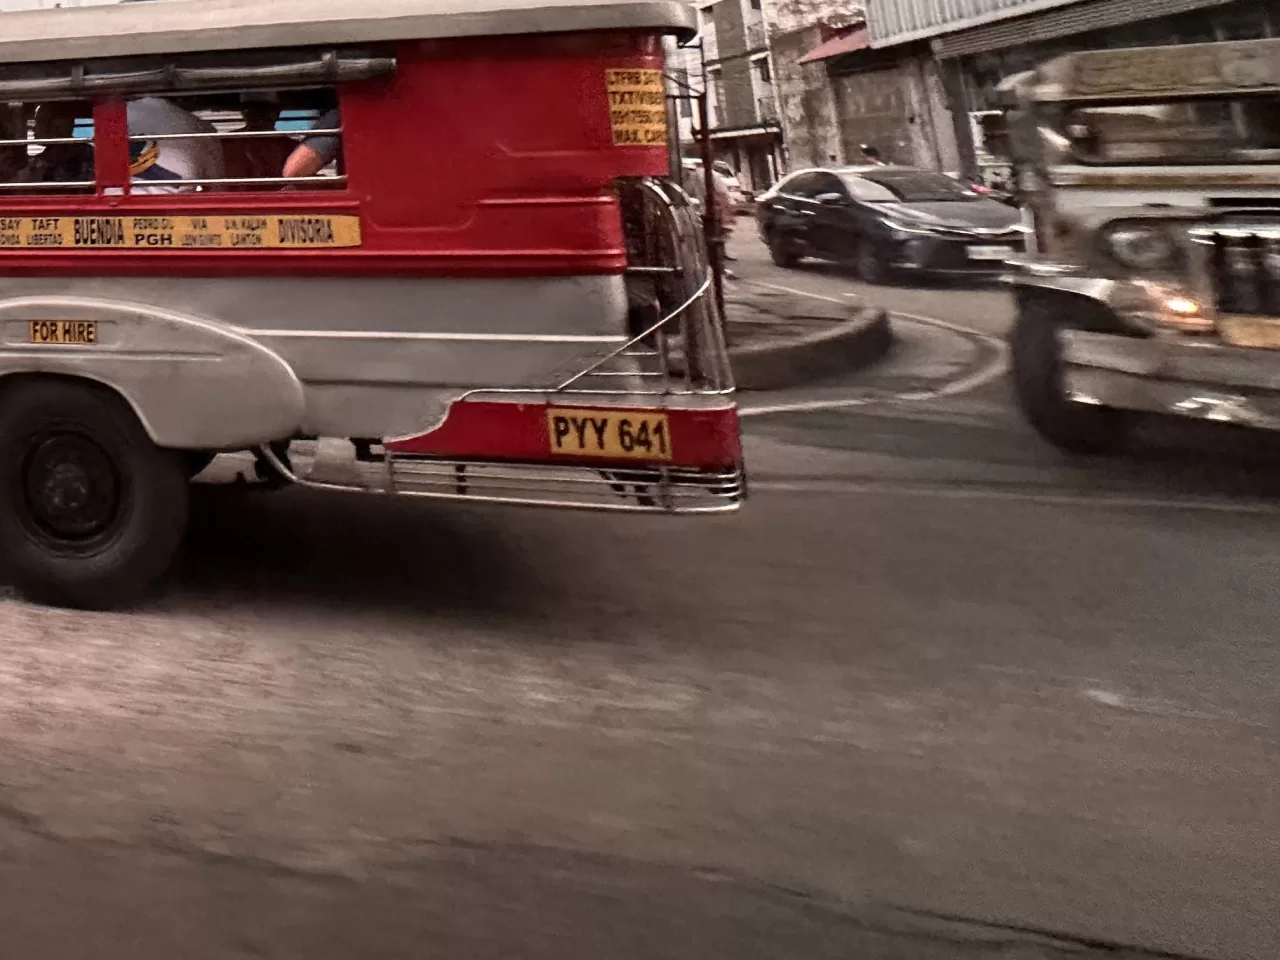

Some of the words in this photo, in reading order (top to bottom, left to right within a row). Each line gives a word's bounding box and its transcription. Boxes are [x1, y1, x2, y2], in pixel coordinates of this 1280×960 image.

[31, 218, 60, 231] TAFT
[73, 217, 125, 245] BUENDIA
[277, 218, 335, 244] DIVISORIA
[135, 233, 173, 246] PGH
[32, 321, 58, 342] FOR
[63, 322, 95, 343] HIRE
[553, 416, 608, 450] PYY
[618, 419, 666, 454] 641
